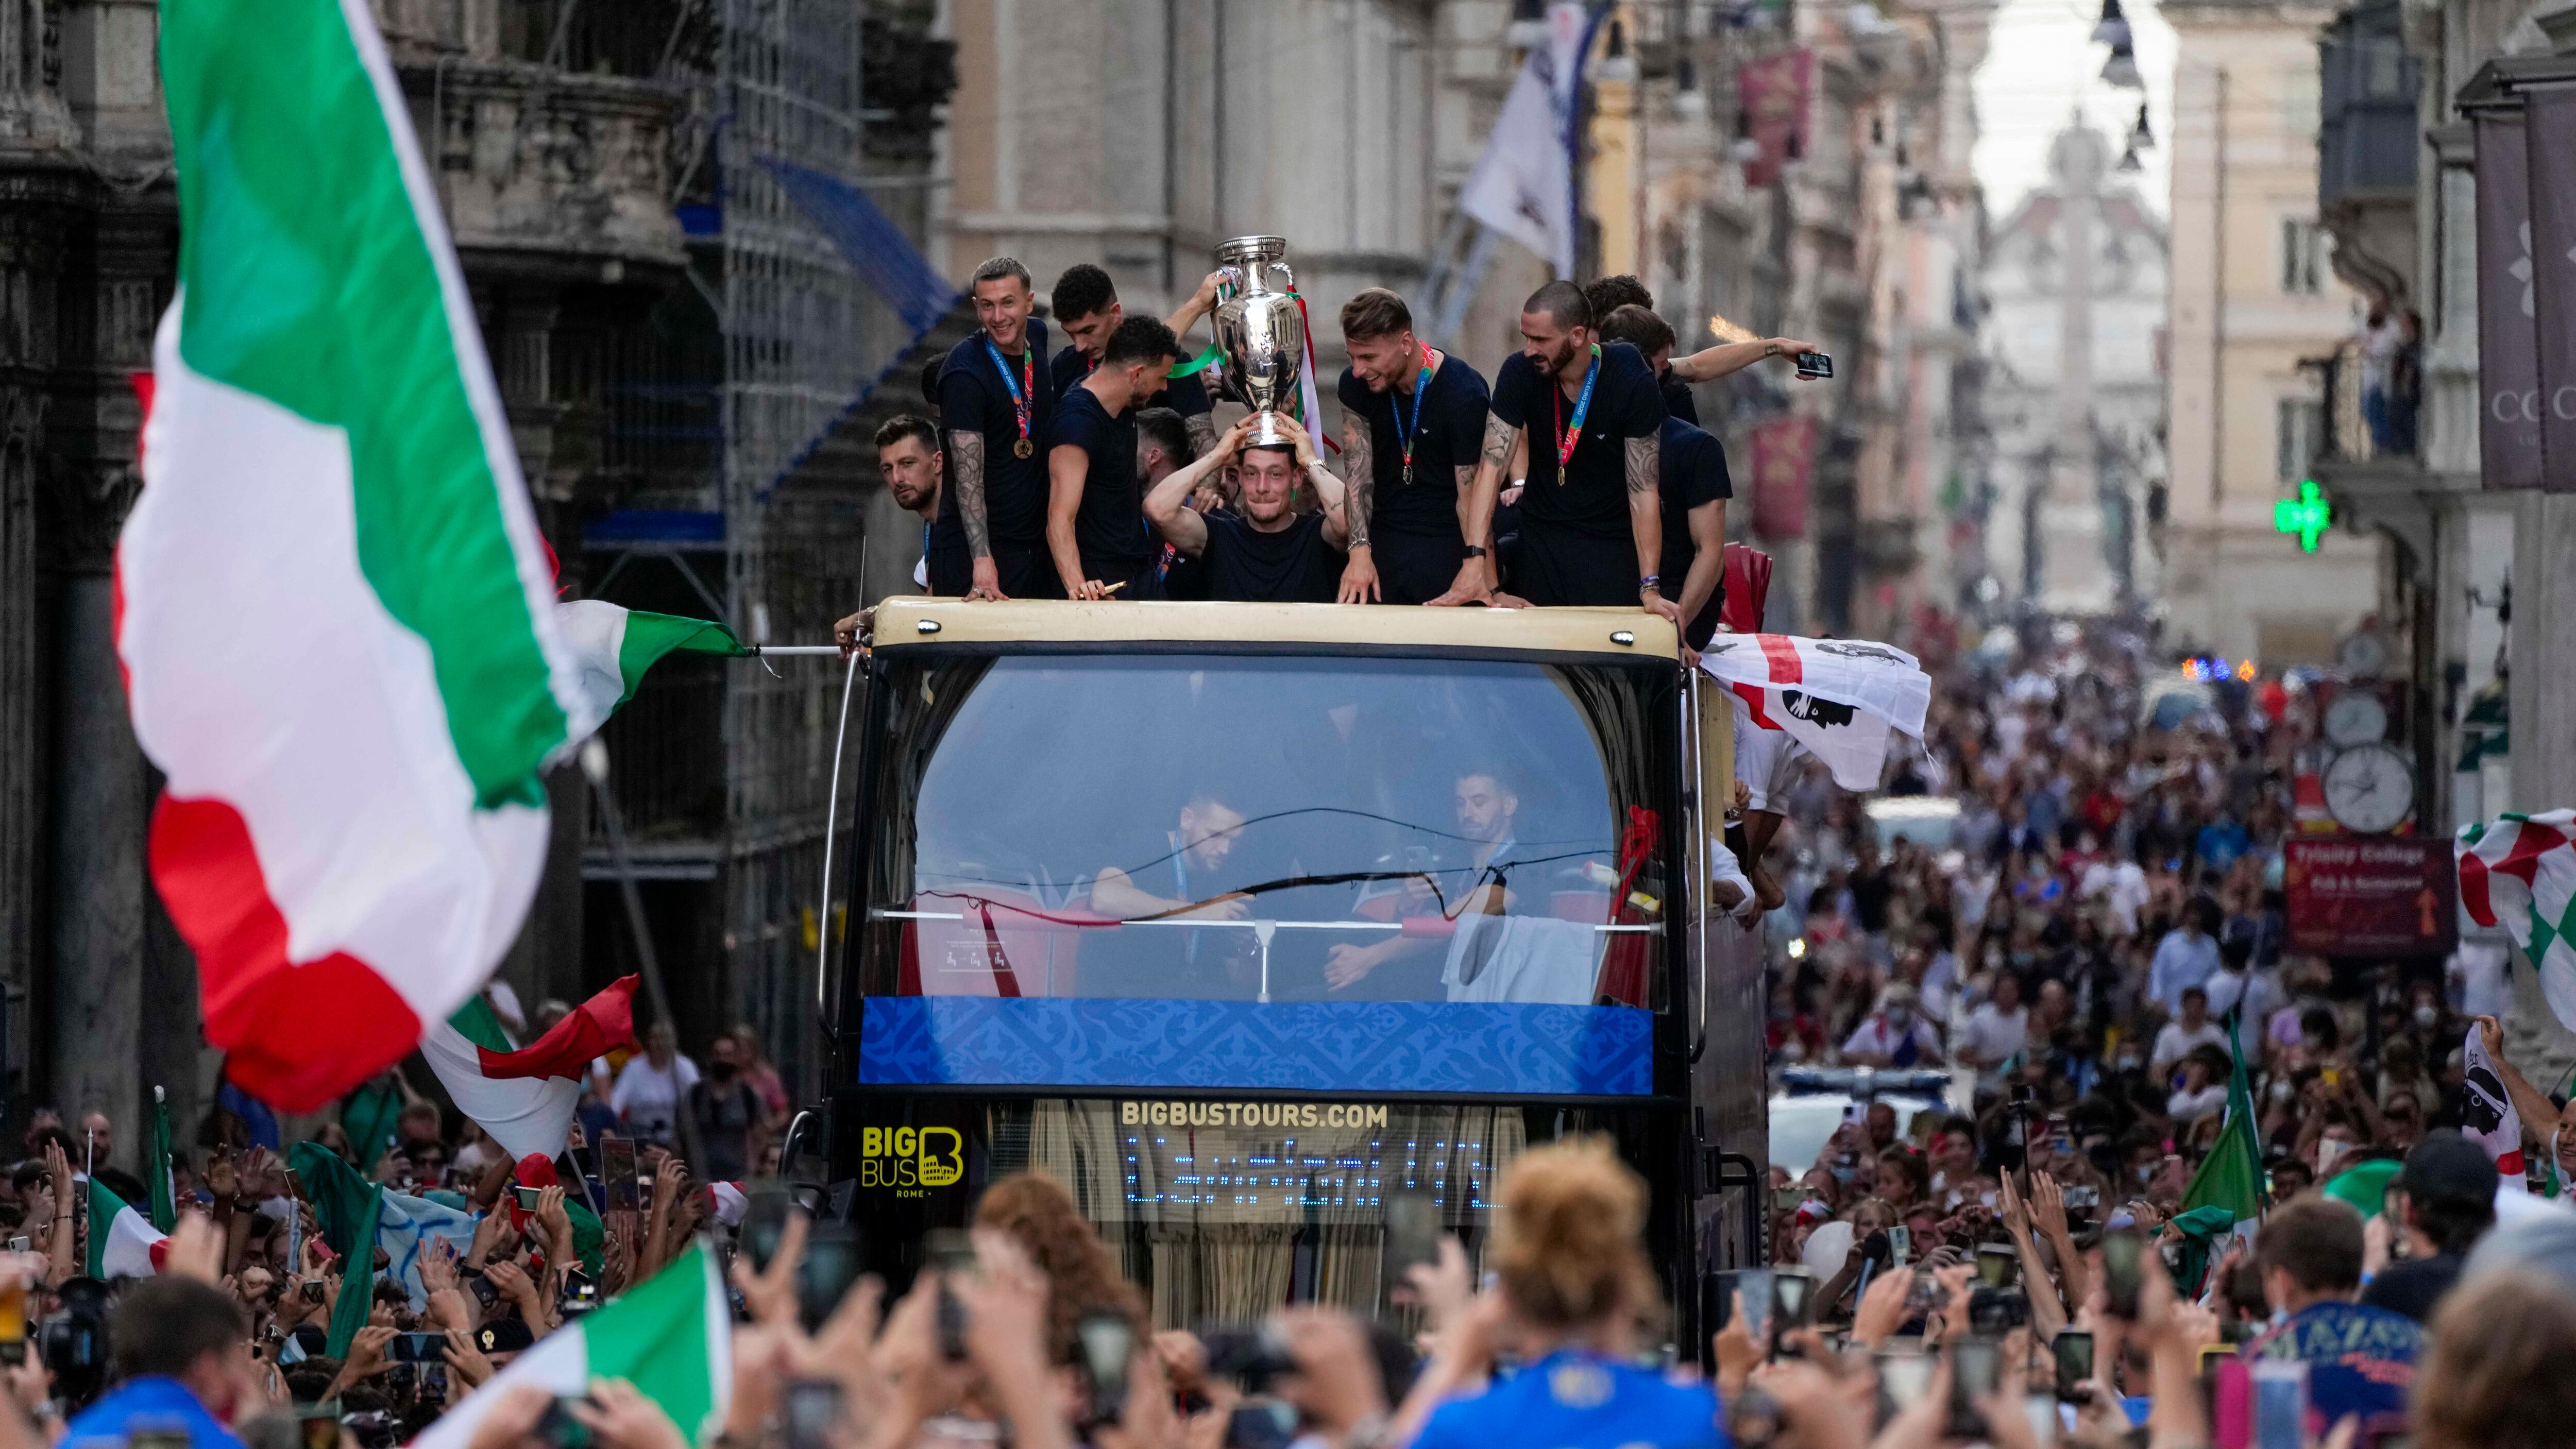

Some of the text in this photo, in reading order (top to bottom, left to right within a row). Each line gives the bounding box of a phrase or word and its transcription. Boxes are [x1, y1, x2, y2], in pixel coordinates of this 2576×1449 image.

[989, 347, 1015, 389] UEFA EURO 2020
[1582, 385, 1590, 401] EURO
[1577, 400, 1586, 416] 2020
[1122, 1102, 1387, 1128] BIGBUSTOURS.COM
[863, 1127, 916, 1157] BIG
[862, 1159, 916, 1187] BUS
[896, 1190, 924, 1198] ROME
